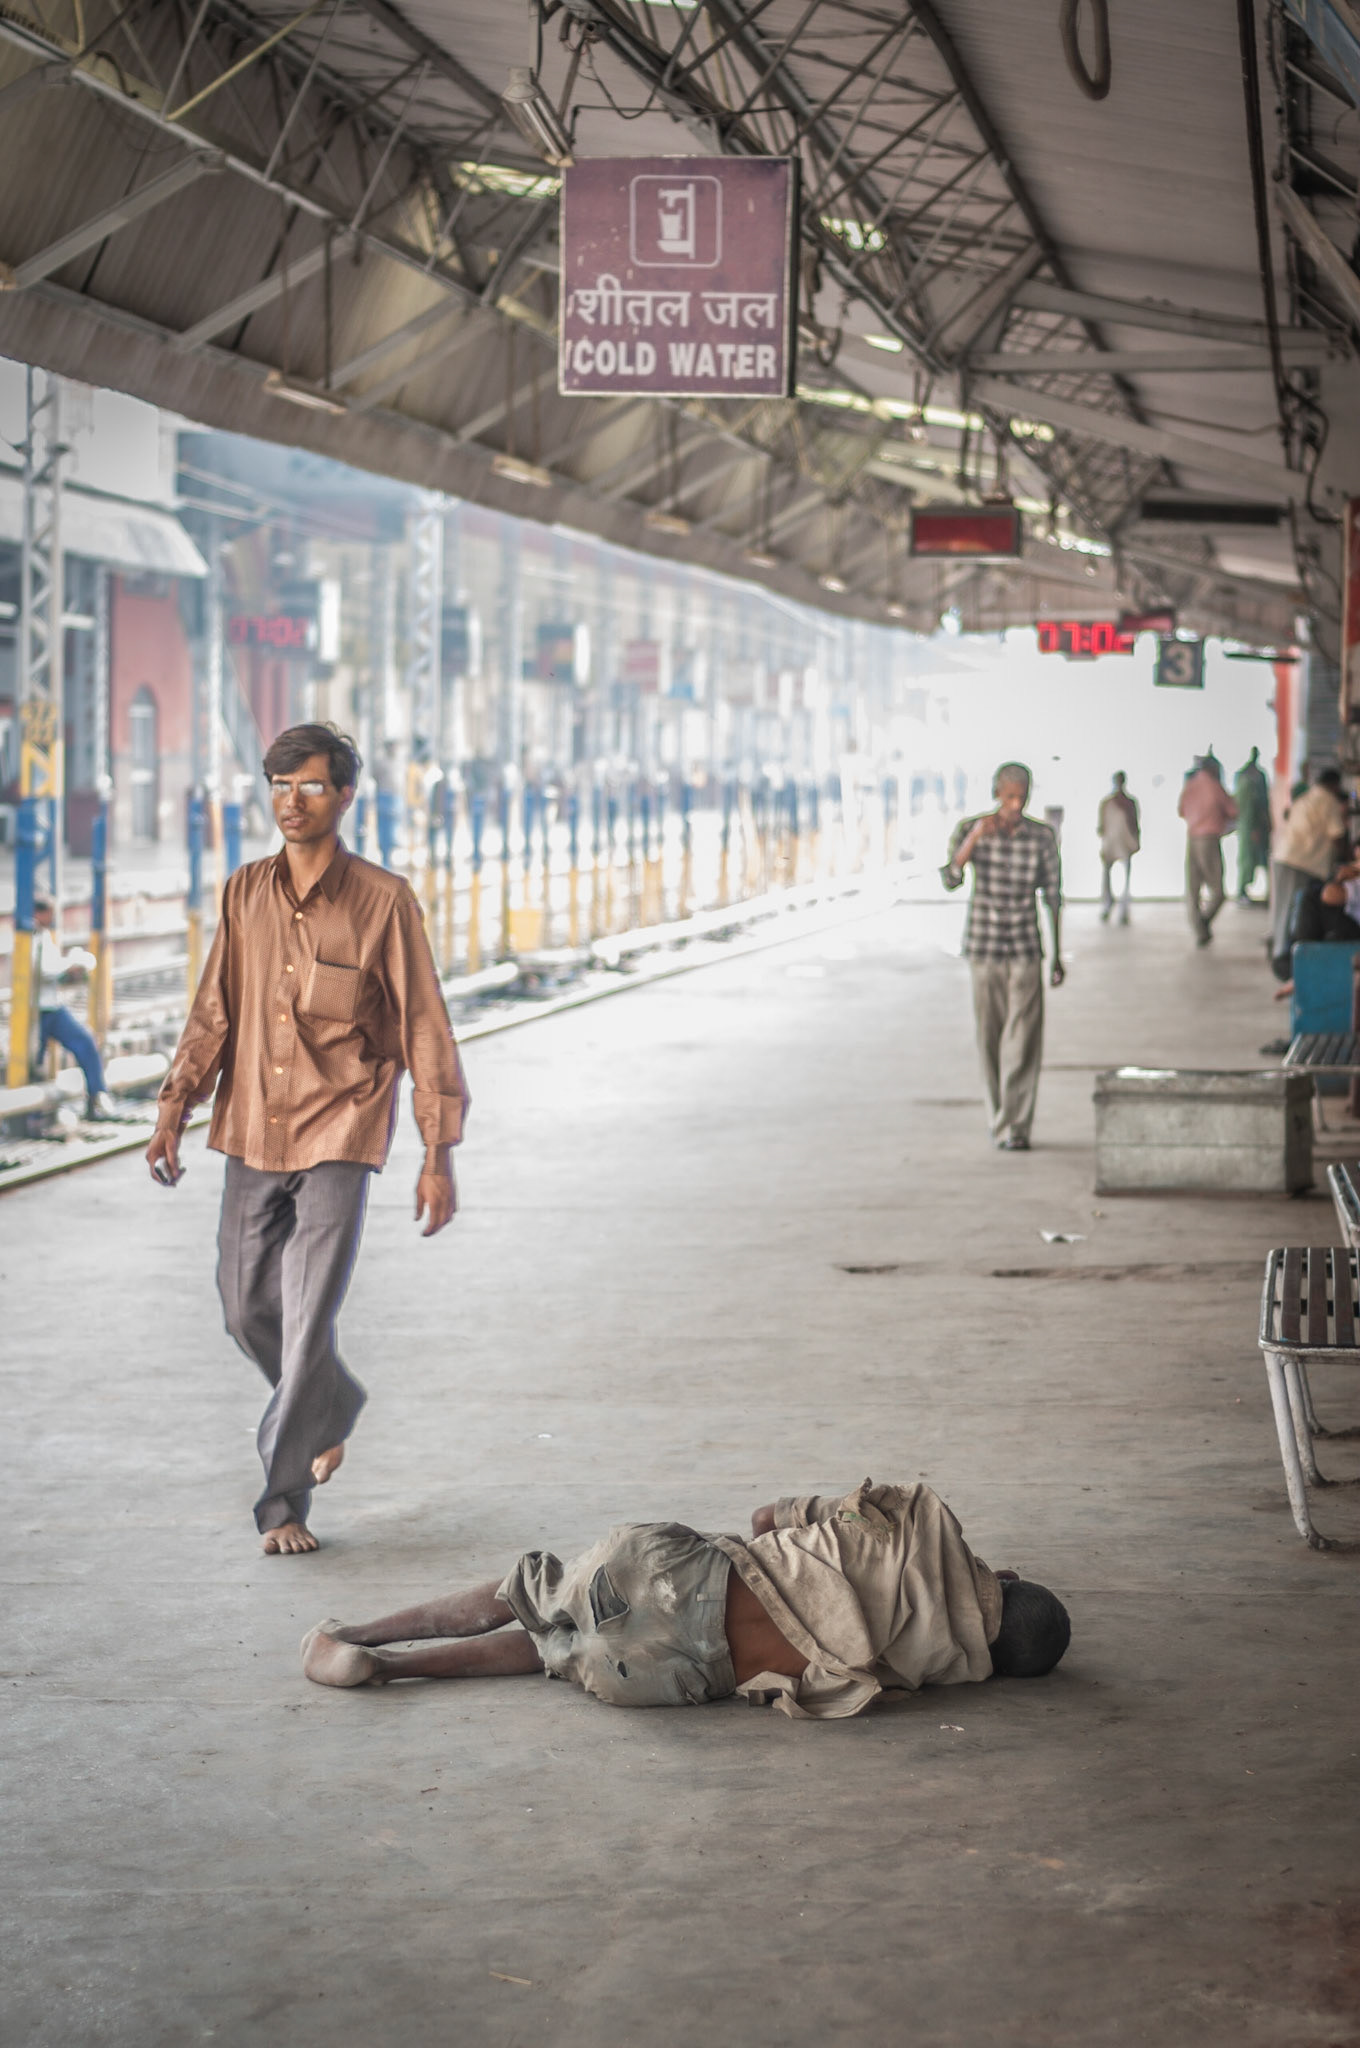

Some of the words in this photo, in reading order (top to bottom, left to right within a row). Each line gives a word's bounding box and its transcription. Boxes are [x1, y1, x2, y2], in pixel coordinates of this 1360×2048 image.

[574, 273, 691, 328] शीतल
[701, 291, 778, 329] जल
[572, 339, 657, 376] COLD
[668, 342, 777, 378] WATER
[1165, 643, 1194, 684] 3
